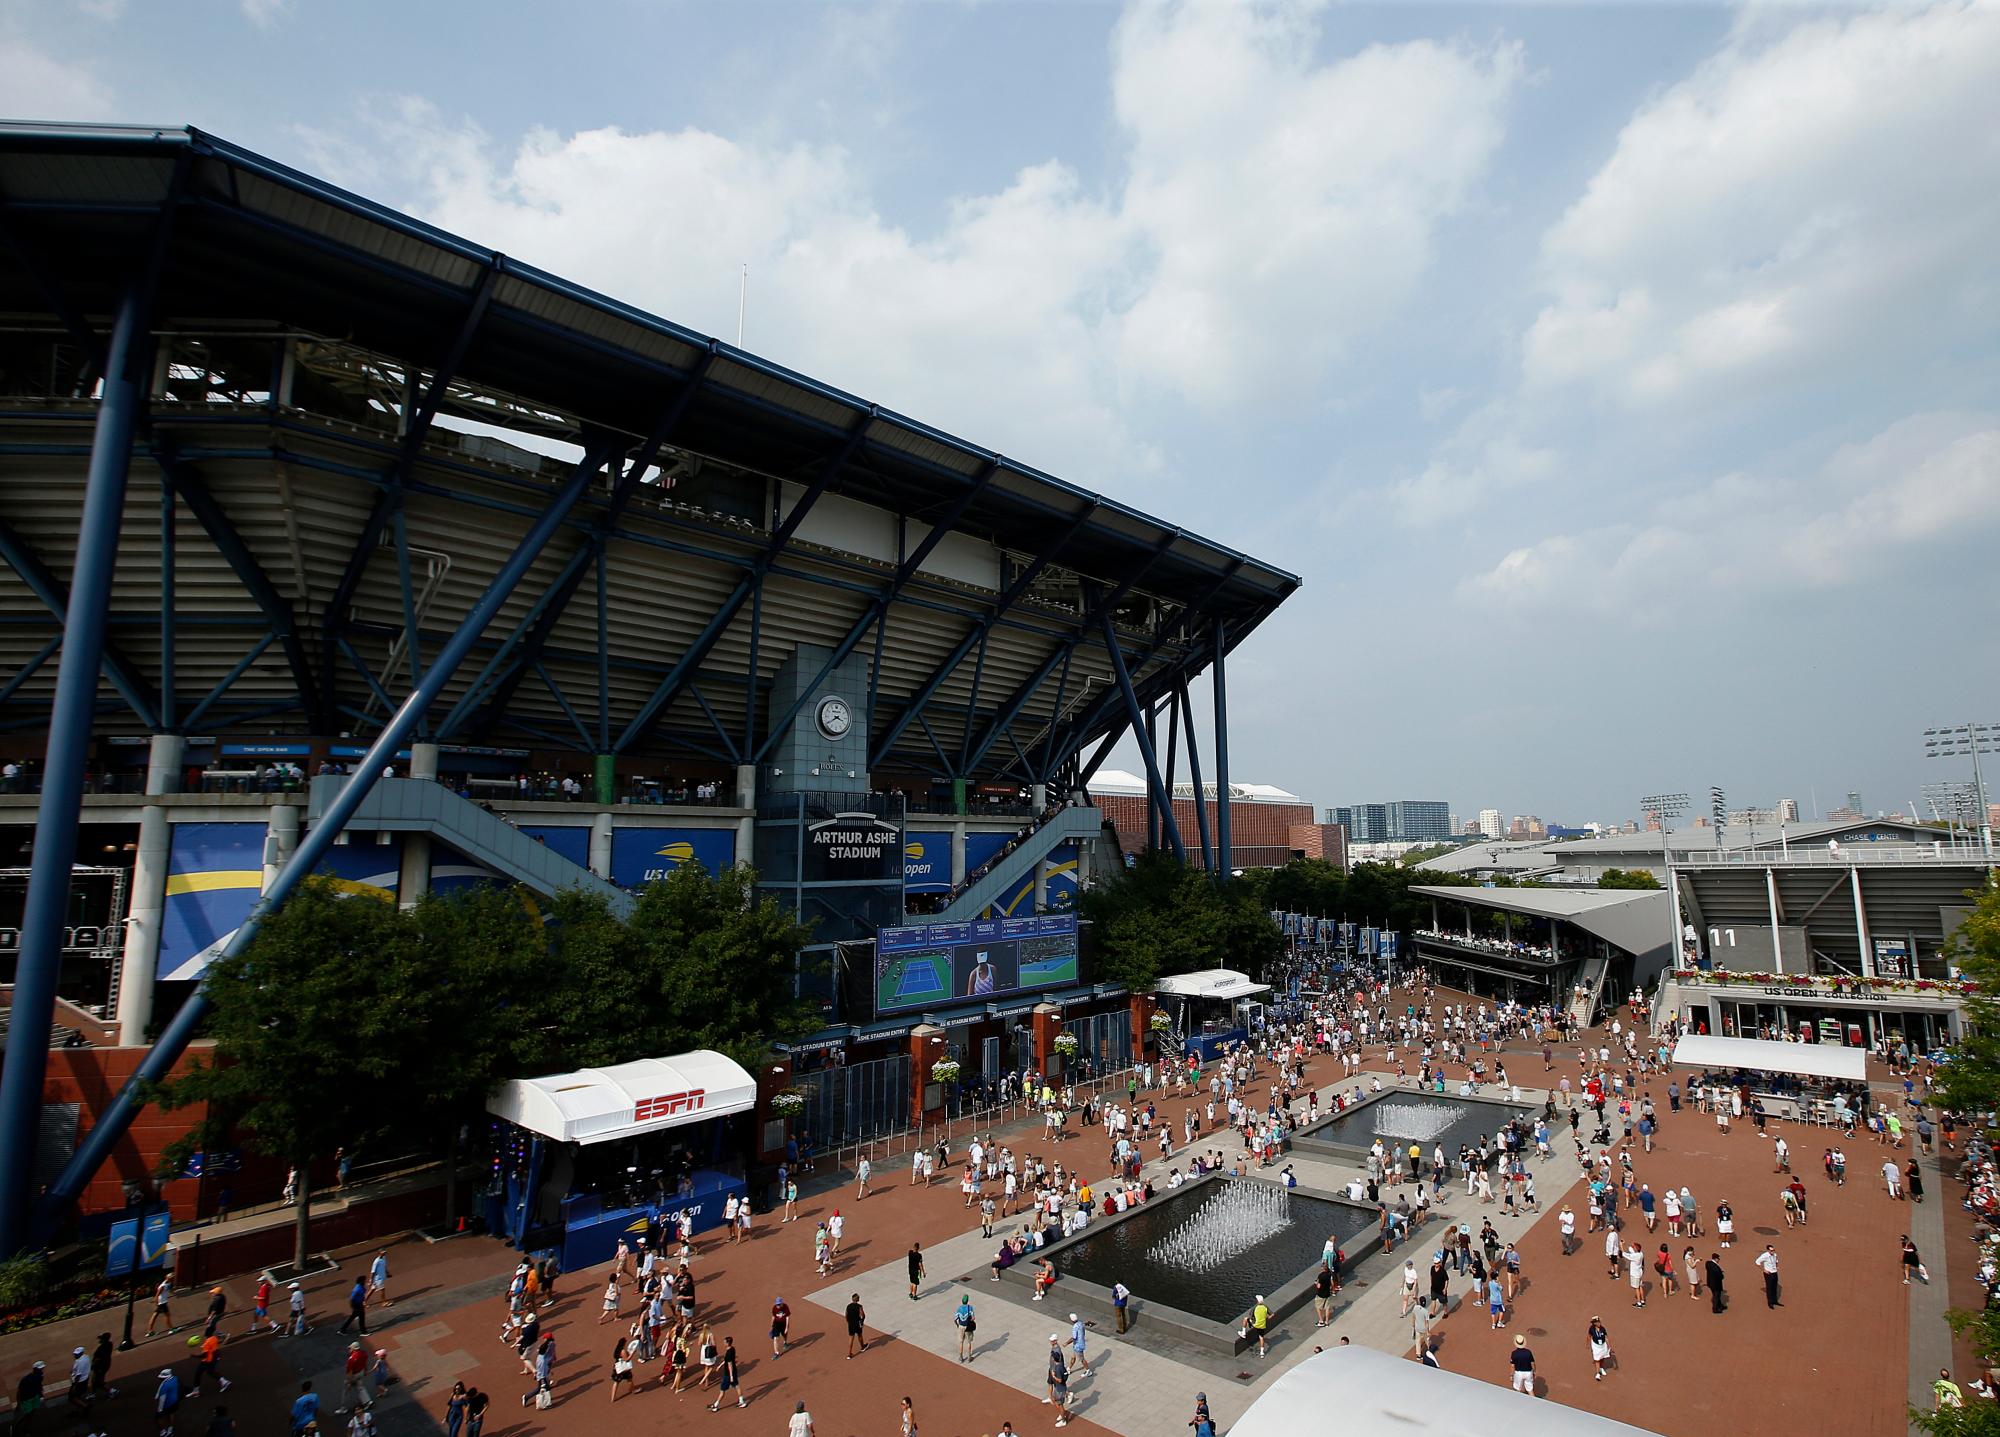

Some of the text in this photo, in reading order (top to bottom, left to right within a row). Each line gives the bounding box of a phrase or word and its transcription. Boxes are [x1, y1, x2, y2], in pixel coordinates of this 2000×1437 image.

[813, 831, 896, 844] ARTHUR ASHE
[1843, 833, 1869, 841] CHASE
[829, 846, 881, 859] STADIUM
[904, 864, 931, 877] open
[1709, 928, 1736, 947] 11
[1764, 987, 1888, 1001] US OPEN COLLECTION
[1002, 1008, 1019, 1016] STADIUM
[951, 1017, 969, 1025] STADIUM
[857, 1028, 906, 1042] ASHE STADIUM ENTRY
[802, 1042, 825, 1051] STADIUM
[825, 1039, 842, 1047] ENTRY
[634, 1088, 705, 1121] ESPN
